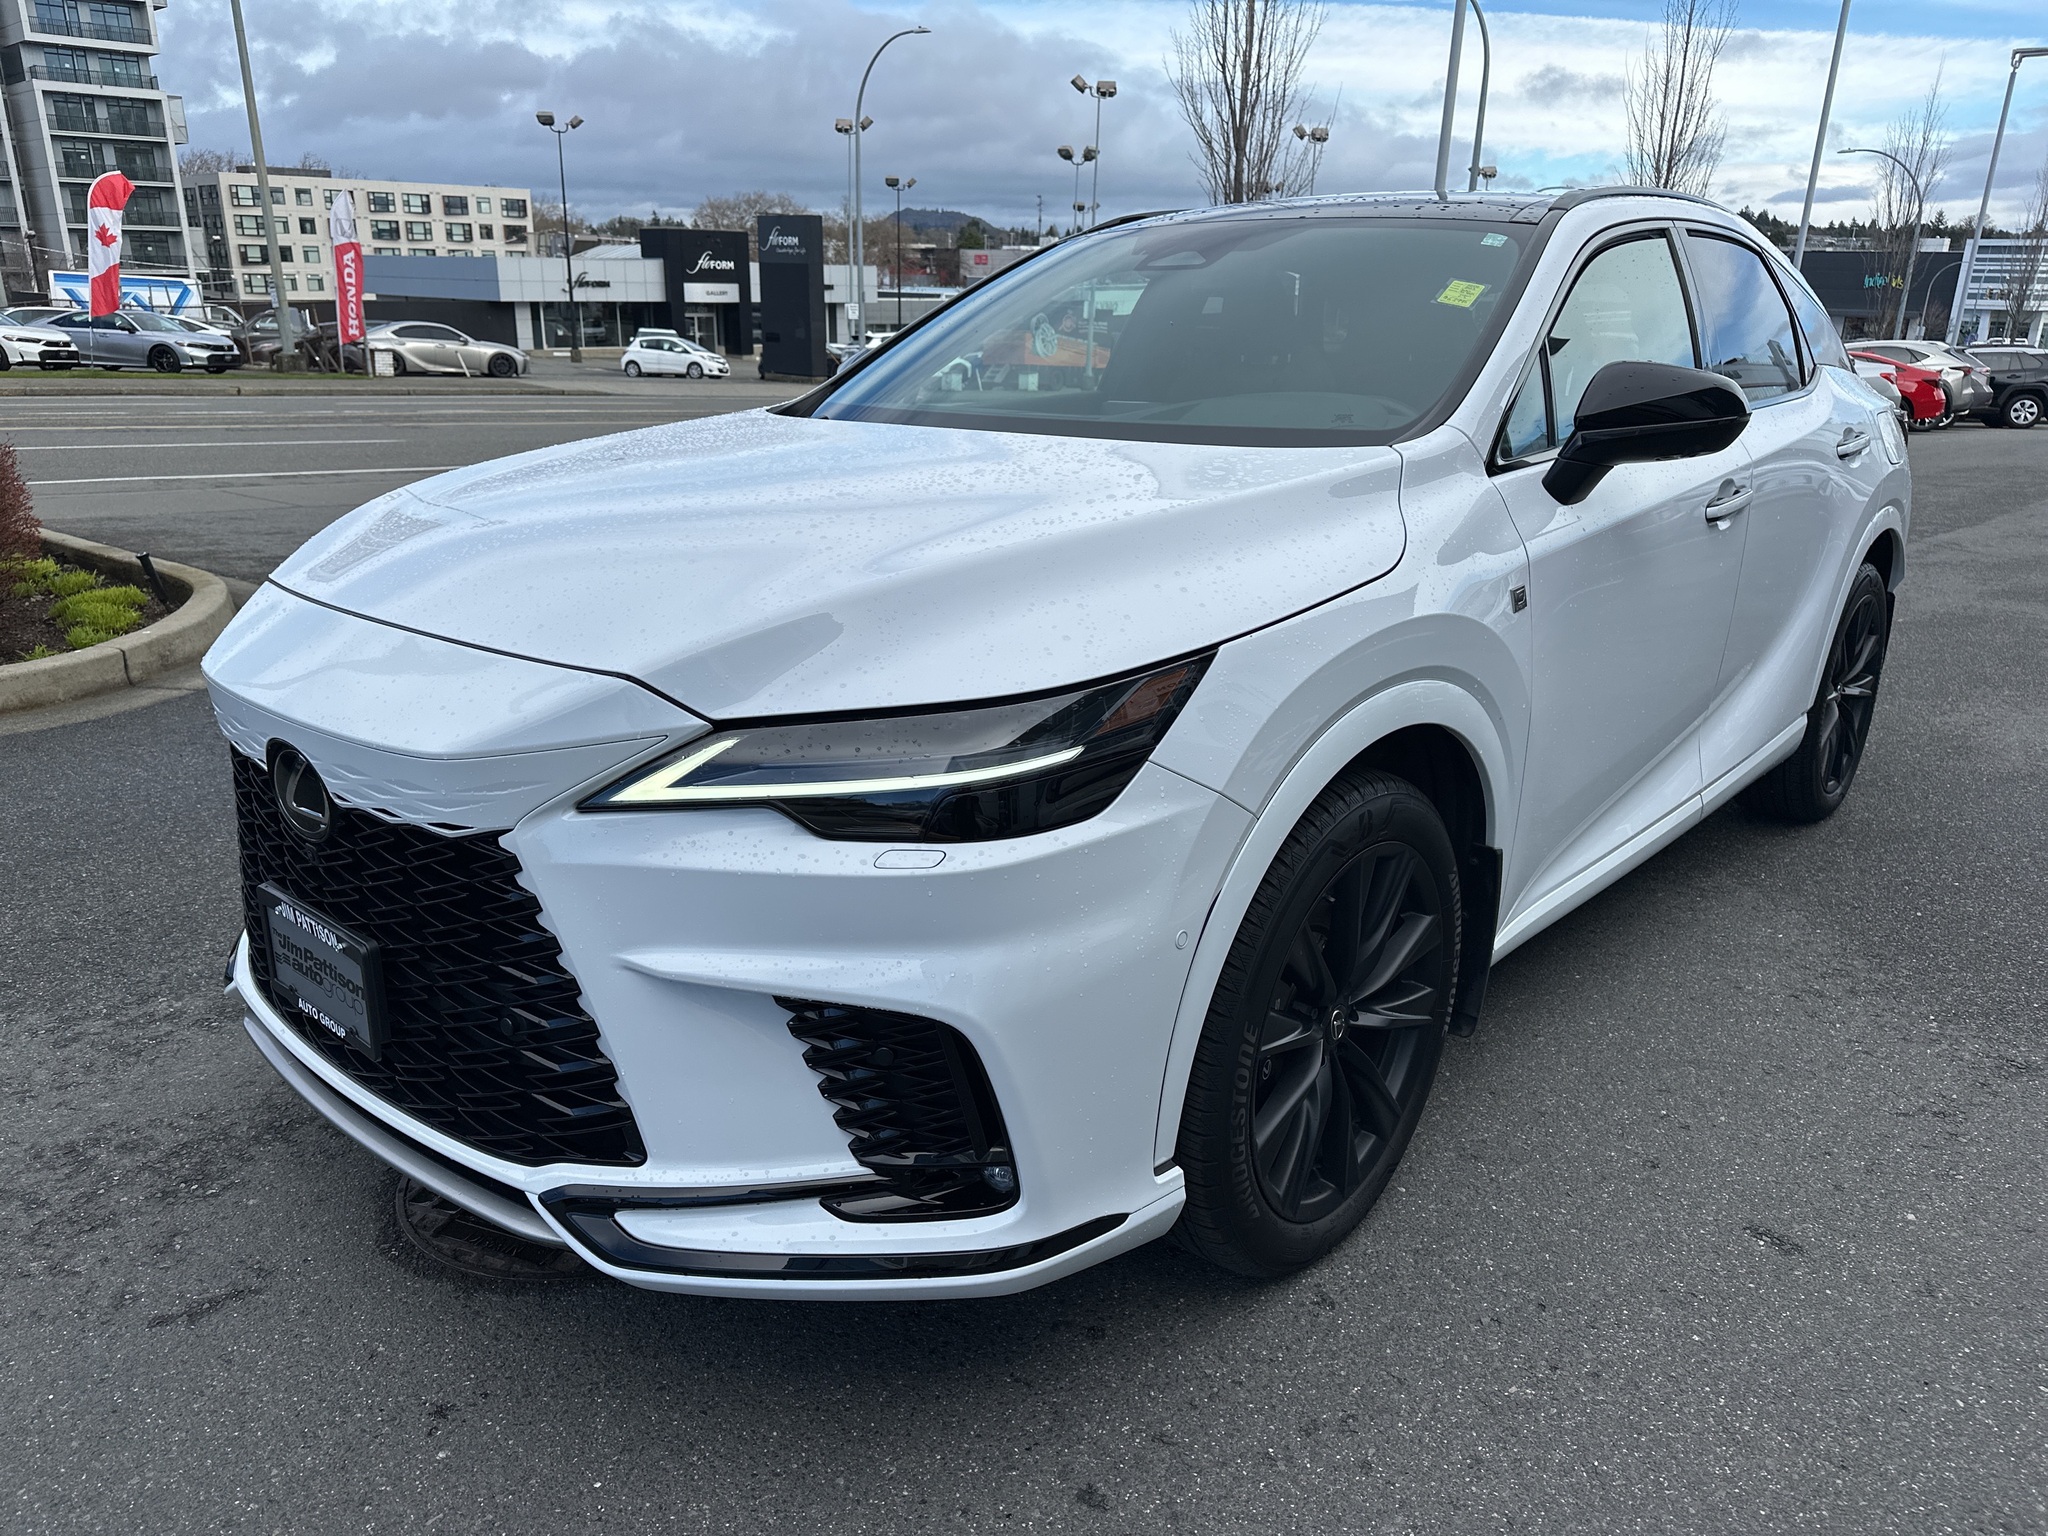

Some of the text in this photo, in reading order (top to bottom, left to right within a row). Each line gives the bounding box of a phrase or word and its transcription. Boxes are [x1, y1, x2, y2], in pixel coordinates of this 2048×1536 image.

[343, 250, 360, 337] HONDA
[280, 901, 339, 950] JIM PATTISON
[298, 997, 347, 1039] AUTO GROUP
